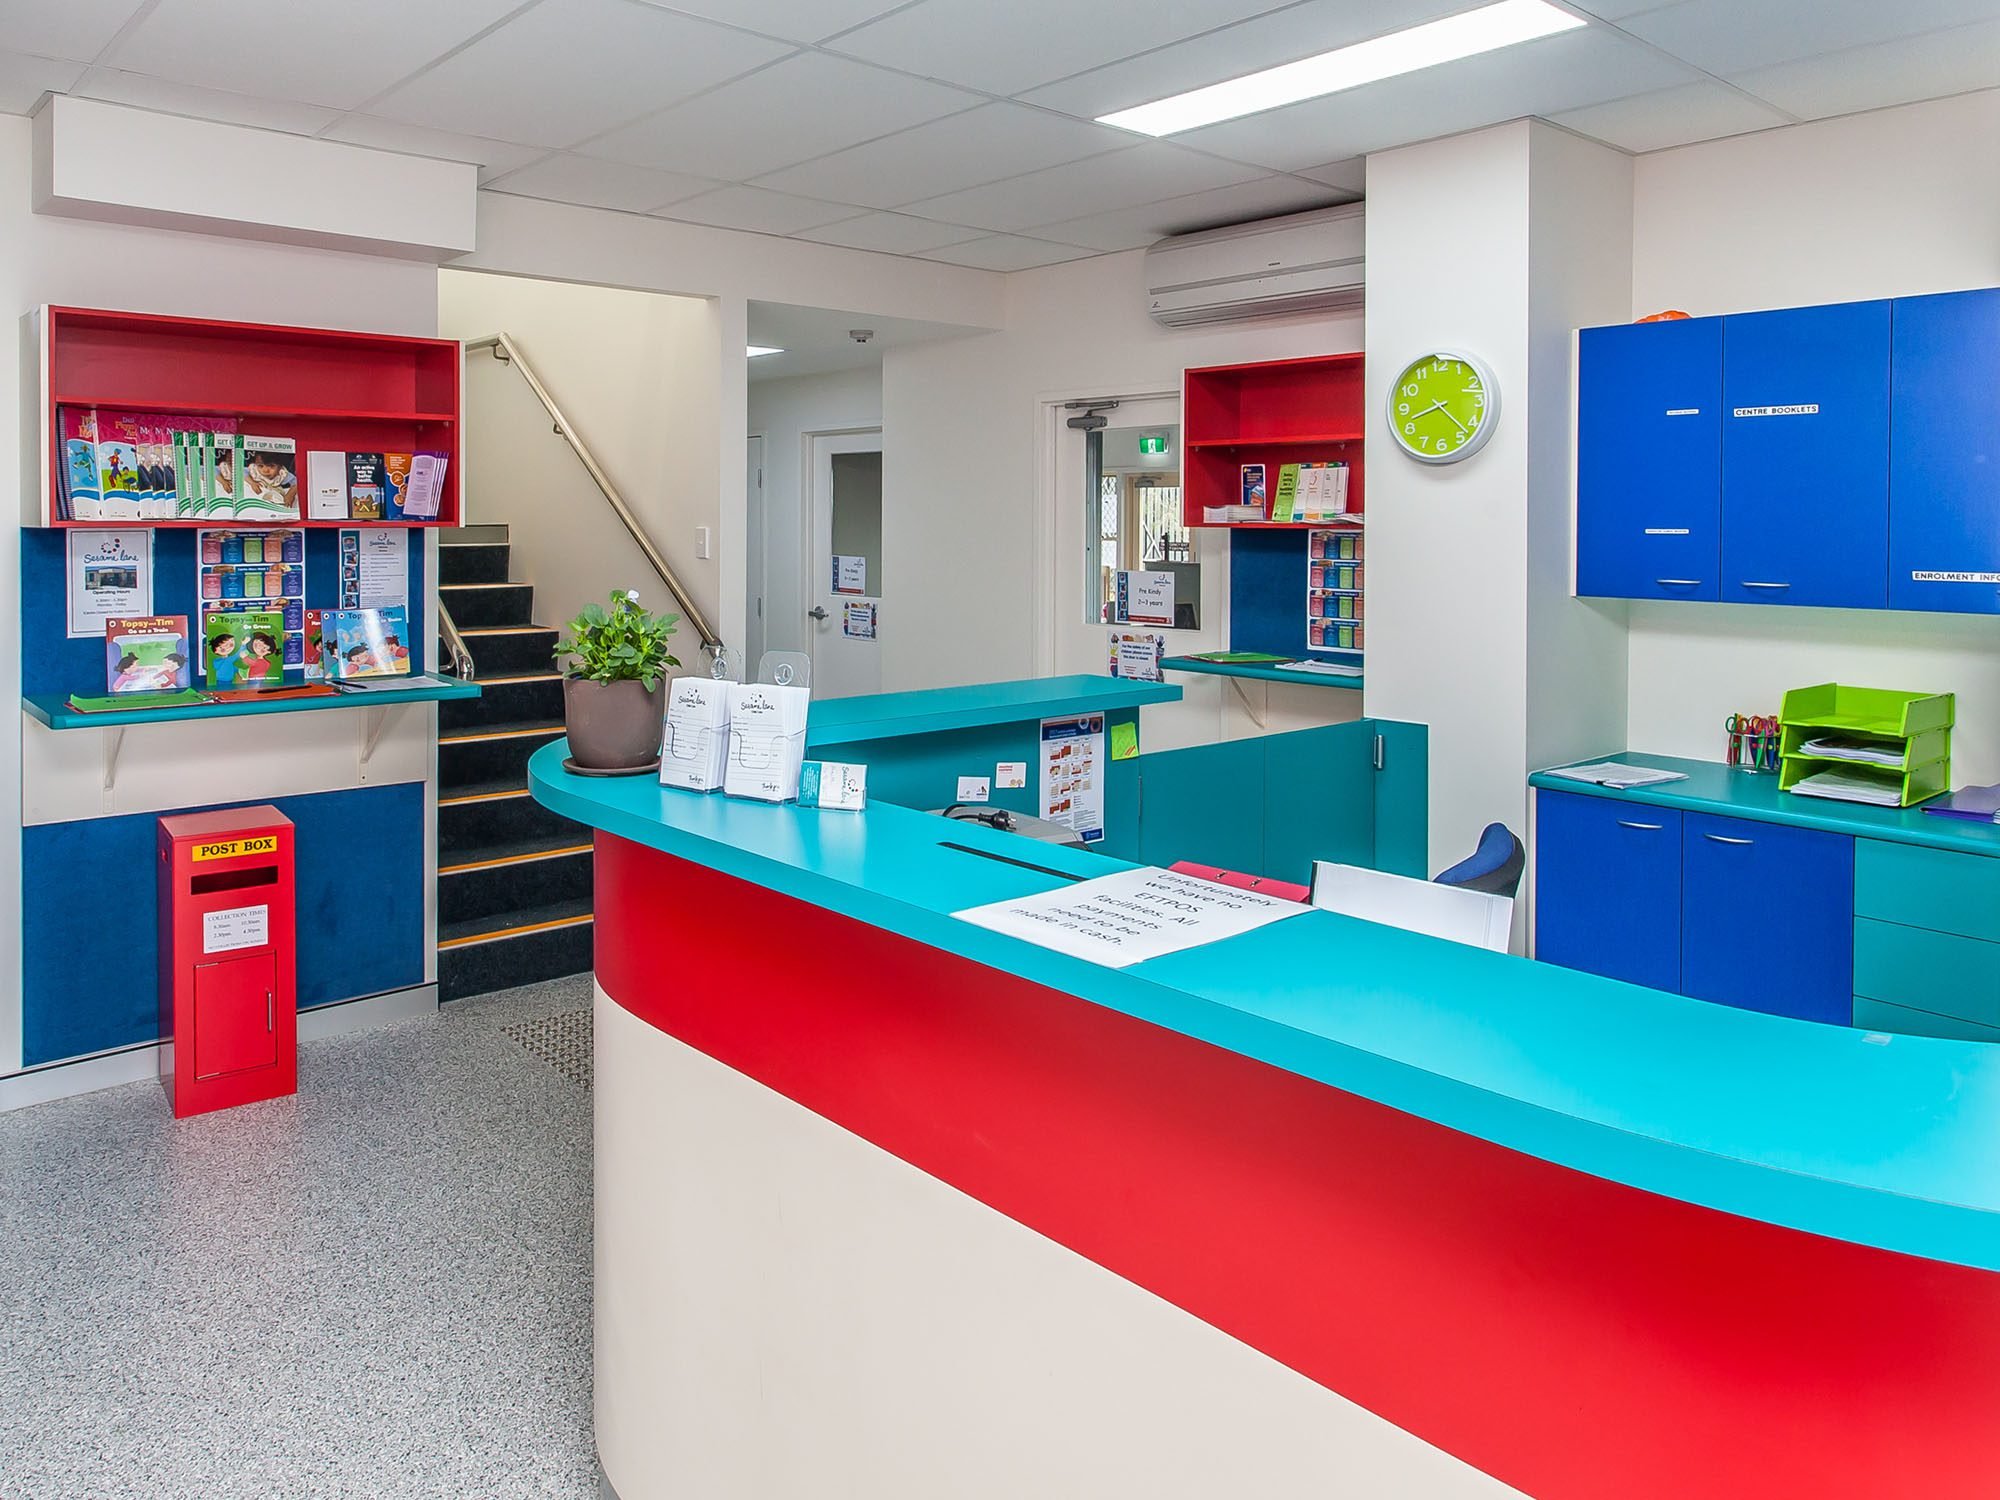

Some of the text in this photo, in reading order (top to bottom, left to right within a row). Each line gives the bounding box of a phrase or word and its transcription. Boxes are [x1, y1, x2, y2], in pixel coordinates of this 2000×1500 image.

[1432, 360, 1448, 372] 12
[1456, 363, 1462, 375] 1
[1416, 367, 1427, 380] 11
[1468, 376, 1479, 388] 2
[1402, 384, 1419, 397] 10
[1474, 394, 1483, 407] 3
[1398, 403, 1410, 416] 9
[1735, 405, 1817, 416] CENTRE BOOKLETS
[1467, 415, 1478, 427] 4
[1405, 422, 1416, 435] 8
[1419, 436, 1429, 448] 7
[1456, 431, 1465, 444] 5
[247, 439, 258, 448] GET
[259, 440, 268, 448] UP
[274, 442, 293, 450] GROW
[1436, 439, 1448, 451] 6
[1914, 572, 1975, 581] ENROLMENT
[1148, 588, 1162, 596] Kindy
[121, 620, 149, 628] Topsy
[156, 618, 174, 626] Tim
[219, 616, 247, 624] Topsy
[252, 615, 269, 623] Tim
[201, 839, 273, 857] POST BOX
[1158, 874, 1279, 907] Unfortunately
[1134, 892, 1203, 914] EFTPOS
[1172, 888, 1216, 902] have
[1217, 901, 1243, 909] no
[208, 912, 247, 921] COLLECTION
[1074, 903, 1163, 930] payments
[1093, 894, 1201, 927] facilities. All
[1010, 908, 1122, 946] made in cash.
[1048, 907, 1141, 937] need to be
